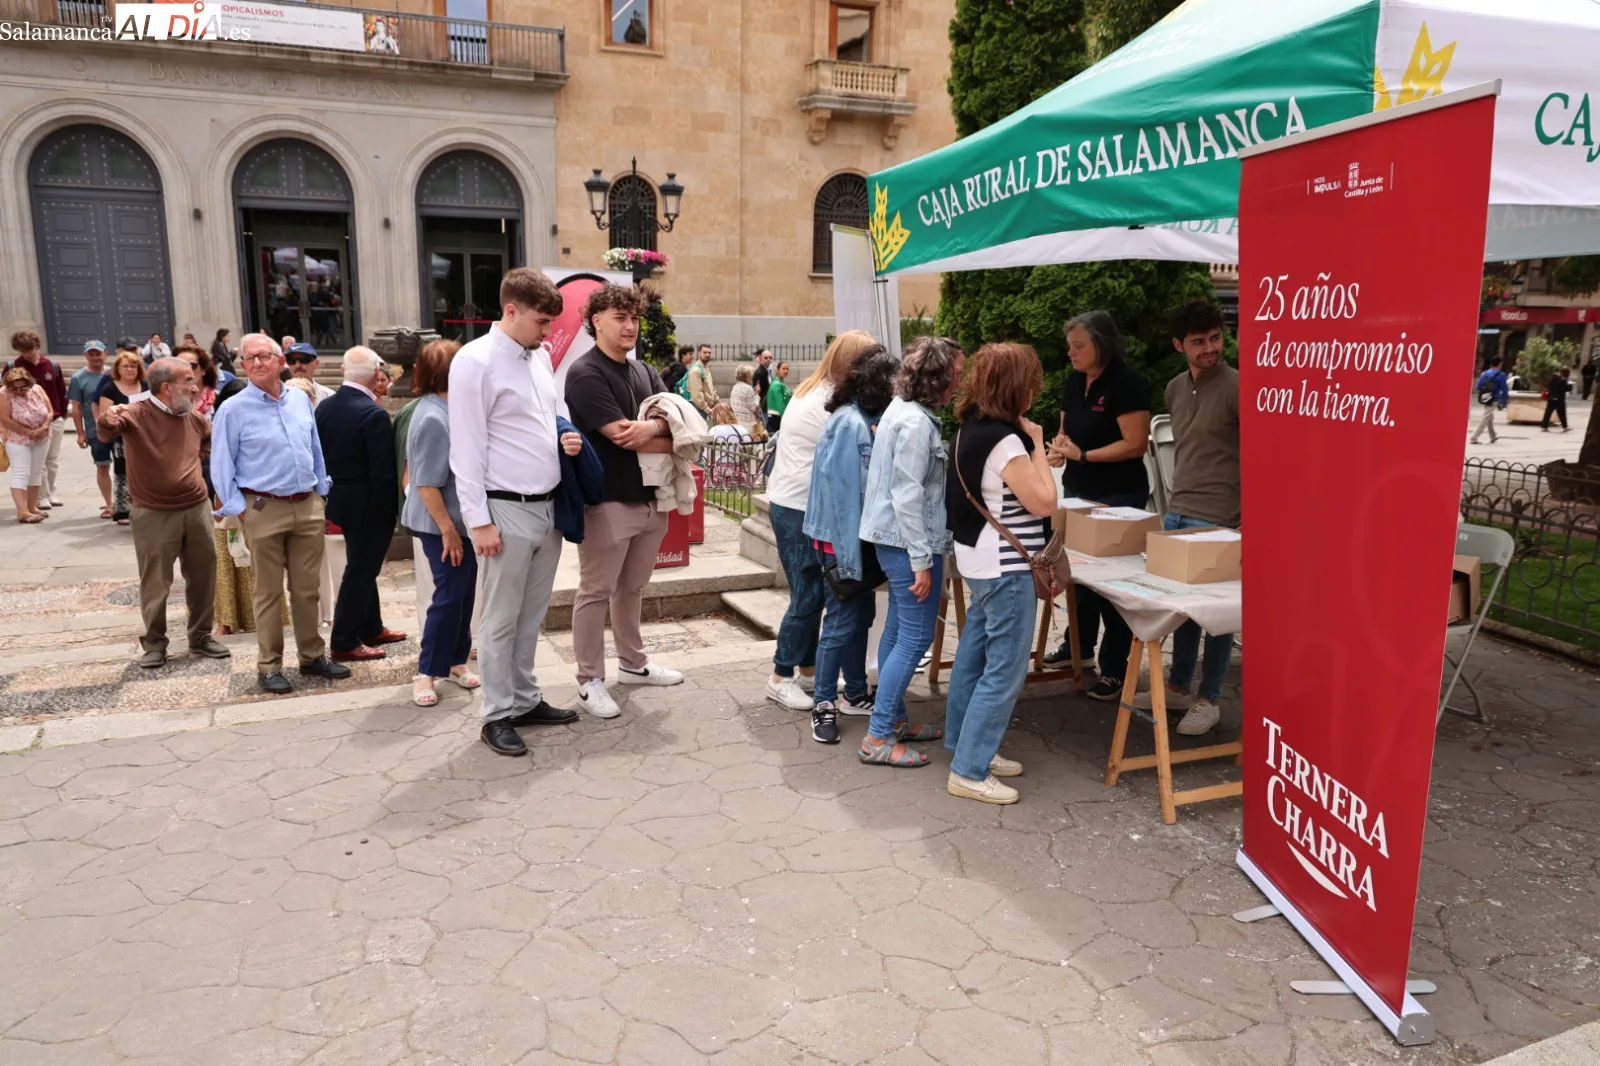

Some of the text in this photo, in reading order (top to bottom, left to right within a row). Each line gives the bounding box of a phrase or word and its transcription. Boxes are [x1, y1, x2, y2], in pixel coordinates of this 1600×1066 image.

[220, 4, 285, 18] OPICALISMOS
[149, 62, 250, 87] BANCO
[269, 72, 297, 92] DE
[917, 96, 1308, 229] CAJA RURAL DE SALAMANCA
[1360, 176, 1384, 188] Junta de
[1344, 187, 1365, 198] Castilla
[1369, 185, 1383, 193] León
[1254, 272, 1360, 321] 25 años
[1256, 331, 1433, 379] de compromiso
[1256, 379, 1395, 427] con la tierra.
[1262, 716, 1390, 859] TERNERA
[1267, 774, 1377, 912] CHARRA
